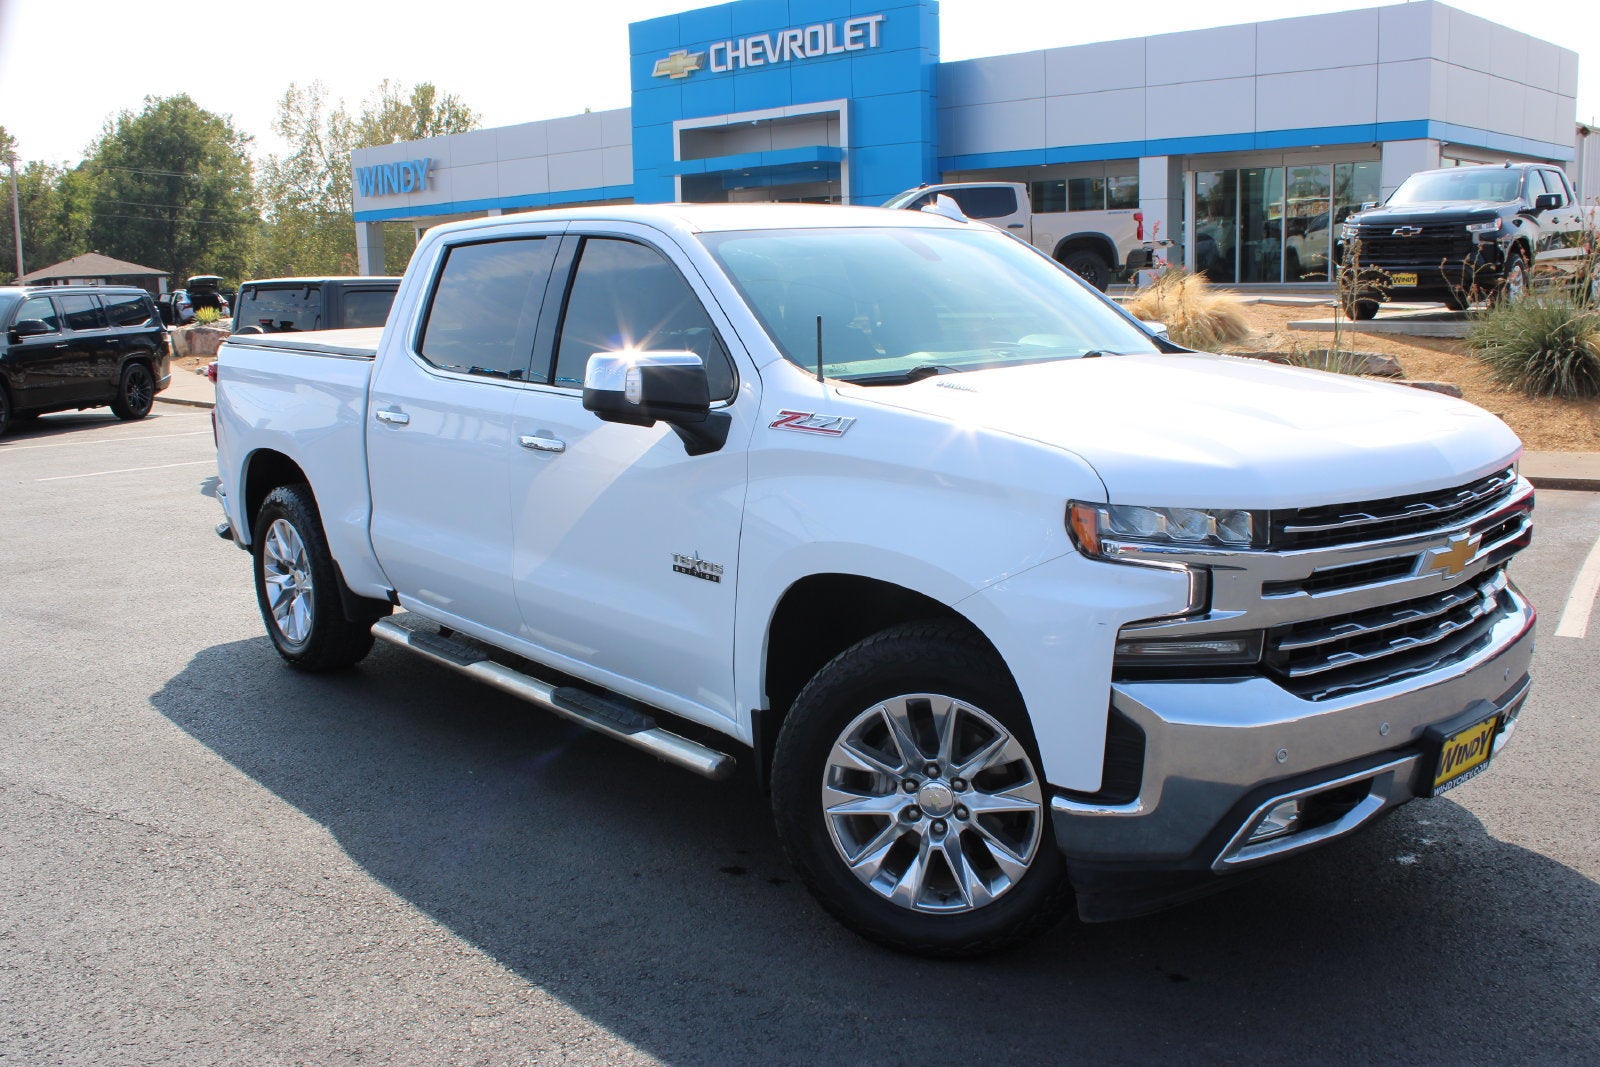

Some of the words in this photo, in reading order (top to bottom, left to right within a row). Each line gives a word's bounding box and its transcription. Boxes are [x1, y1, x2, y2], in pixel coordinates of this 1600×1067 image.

[709, 14, 886, 73] CHEVROLET
[356, 157, 432, 197] WINDY
[768, 409, 857, 437] Z71
[1436, 726, 1494, 777] WINDY
